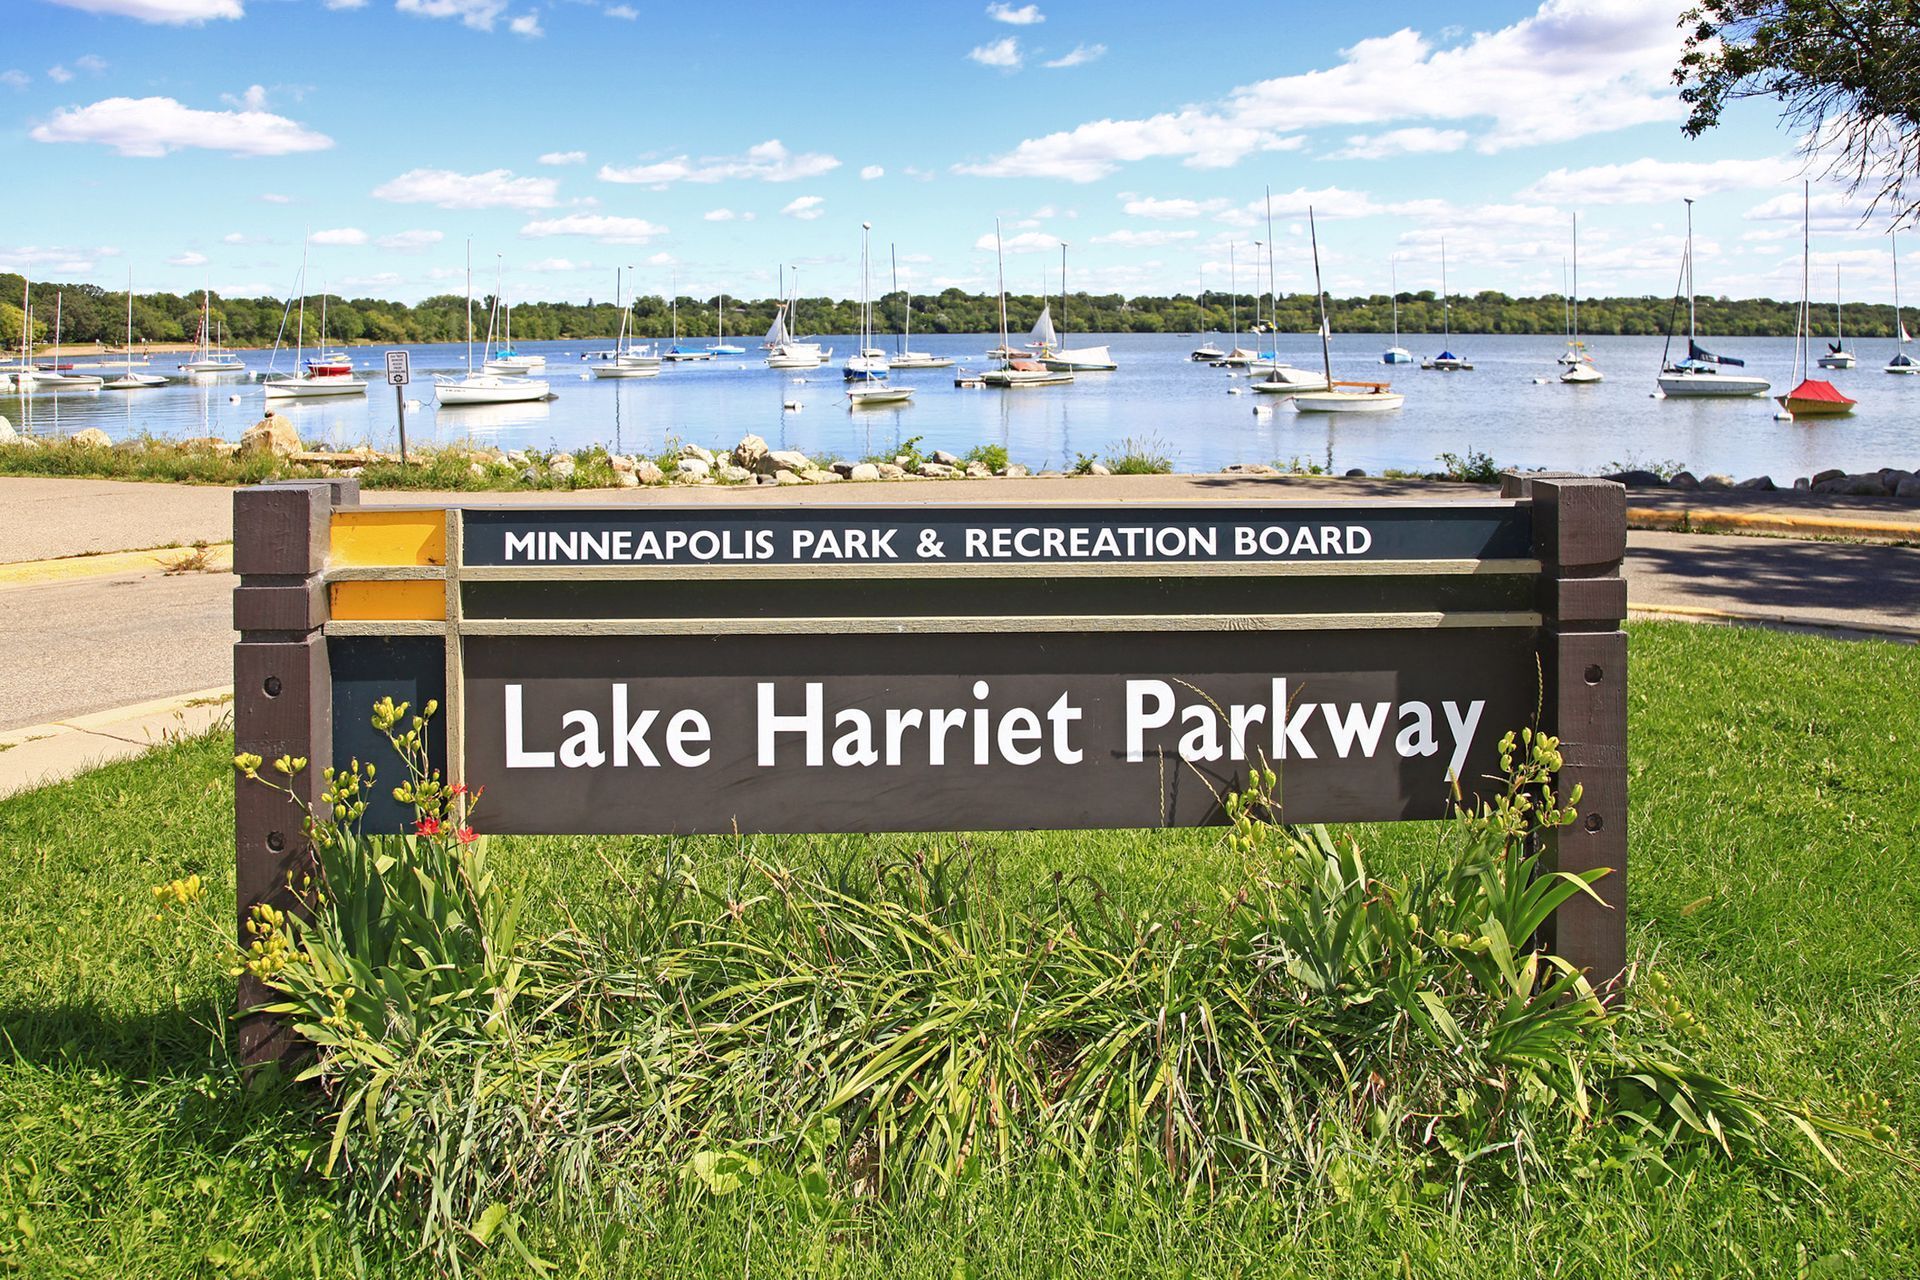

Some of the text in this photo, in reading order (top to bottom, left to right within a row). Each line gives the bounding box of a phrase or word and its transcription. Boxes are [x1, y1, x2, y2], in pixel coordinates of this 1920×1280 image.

[505, 526, 1372, 561] MINNEAPOLIS PARK & RECREATION BOARD
[505, 677, 1486, 783] Lake Harriet Parkway
